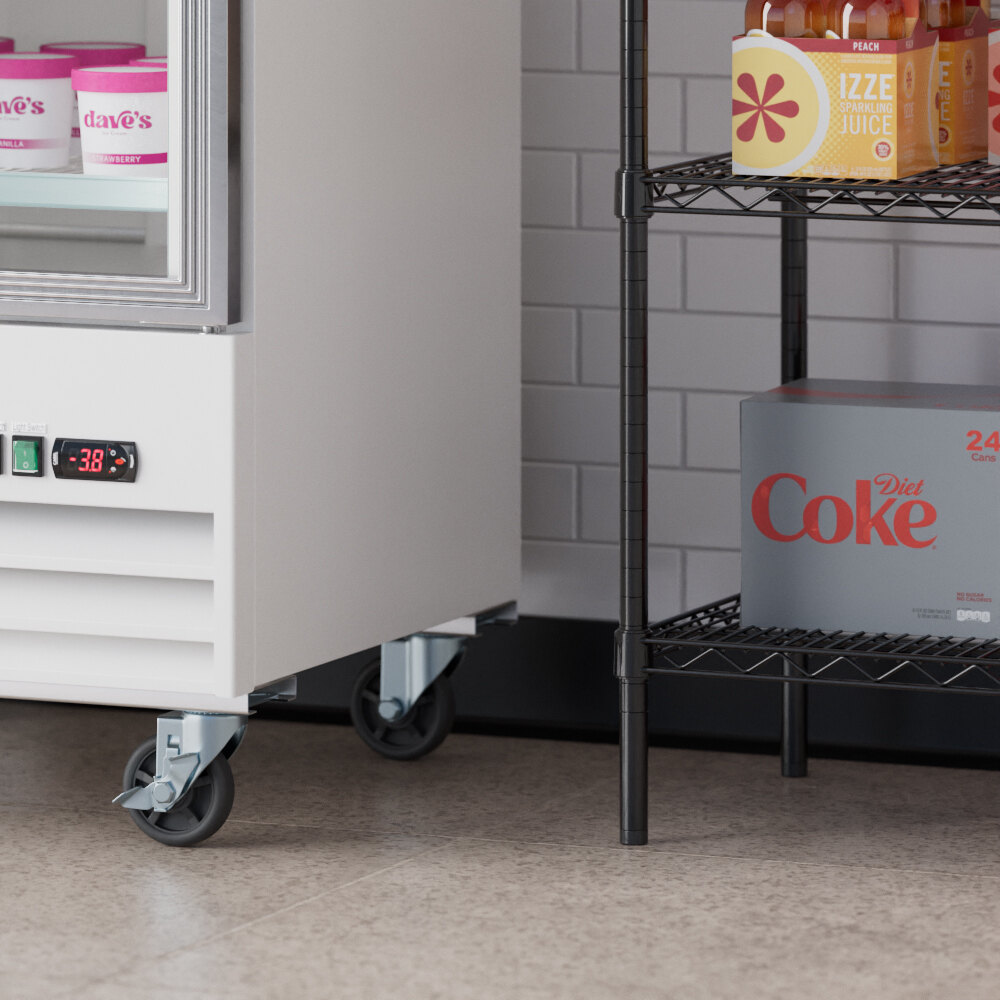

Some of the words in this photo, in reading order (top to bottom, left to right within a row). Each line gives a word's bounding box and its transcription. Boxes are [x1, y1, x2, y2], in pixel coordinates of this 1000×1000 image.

[852, 41, 880, 52] PEACH
[839, 72, 893, 100] IZZE
[839, 101, 893, 115] SPARKLING
[83, 110, 153, 131] dave's
[839, 114, 893, 135] JUICE
[965, 429, 1000, 453] 24
[971, 452, 997, 463] Cans
[873, 472, 925, 497] Diet
[751, 472, 938, 549] Coke
